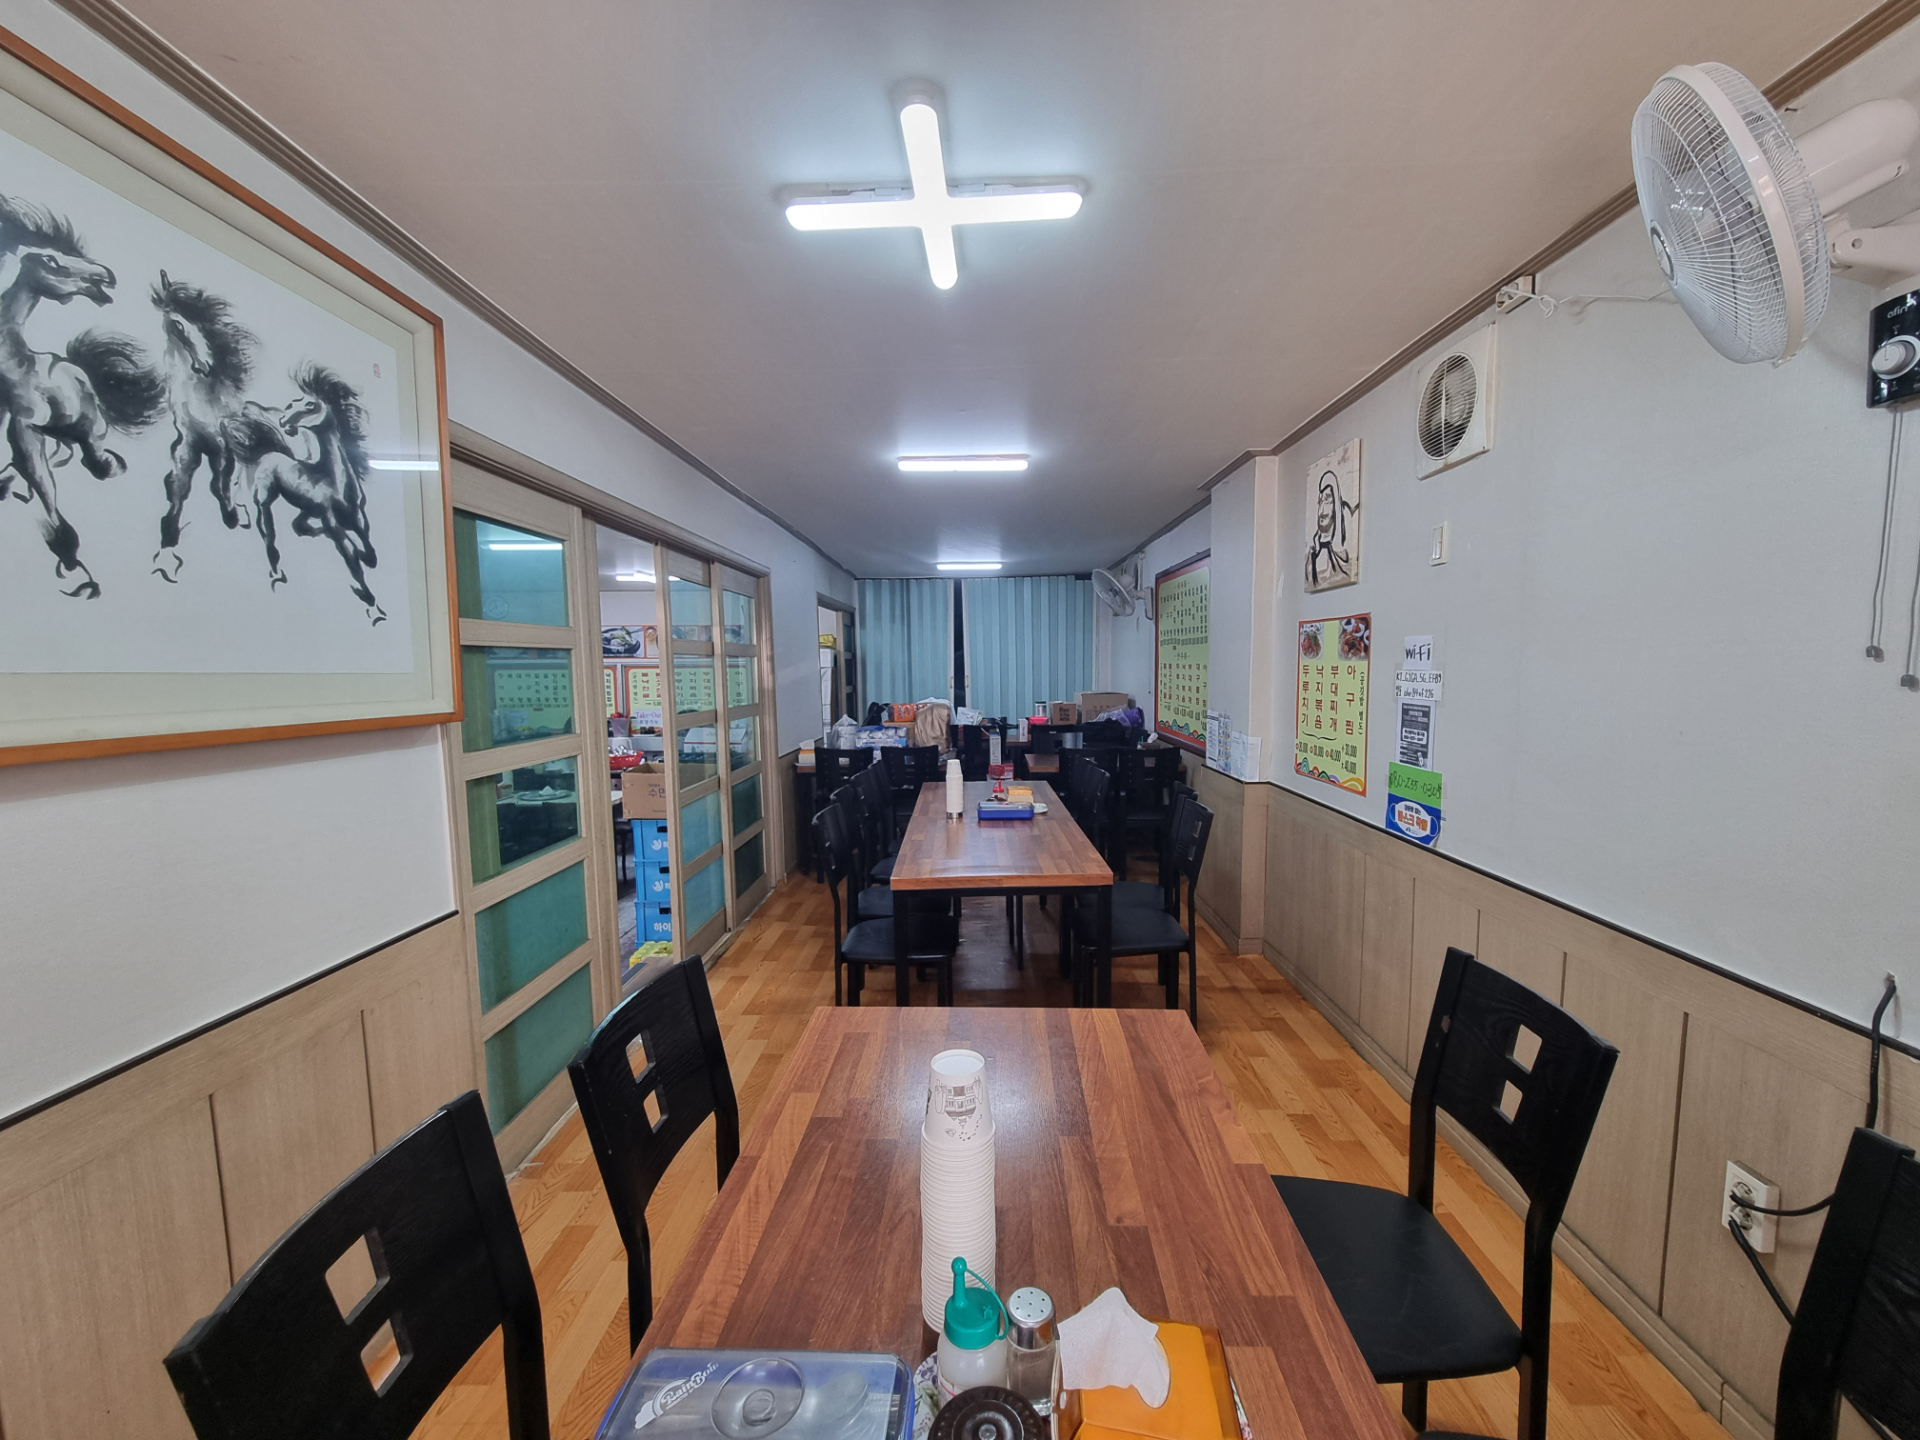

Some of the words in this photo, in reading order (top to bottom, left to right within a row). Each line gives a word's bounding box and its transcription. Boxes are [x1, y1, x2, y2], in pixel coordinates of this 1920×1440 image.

[1302, 665, 1310, 727] 두루치기
[1315, 665, 1324, 730] 낙지볶음
[1329, 665, 1339, 732] 부대찌개
[1345, 665, 1356, 735] 아구찜
